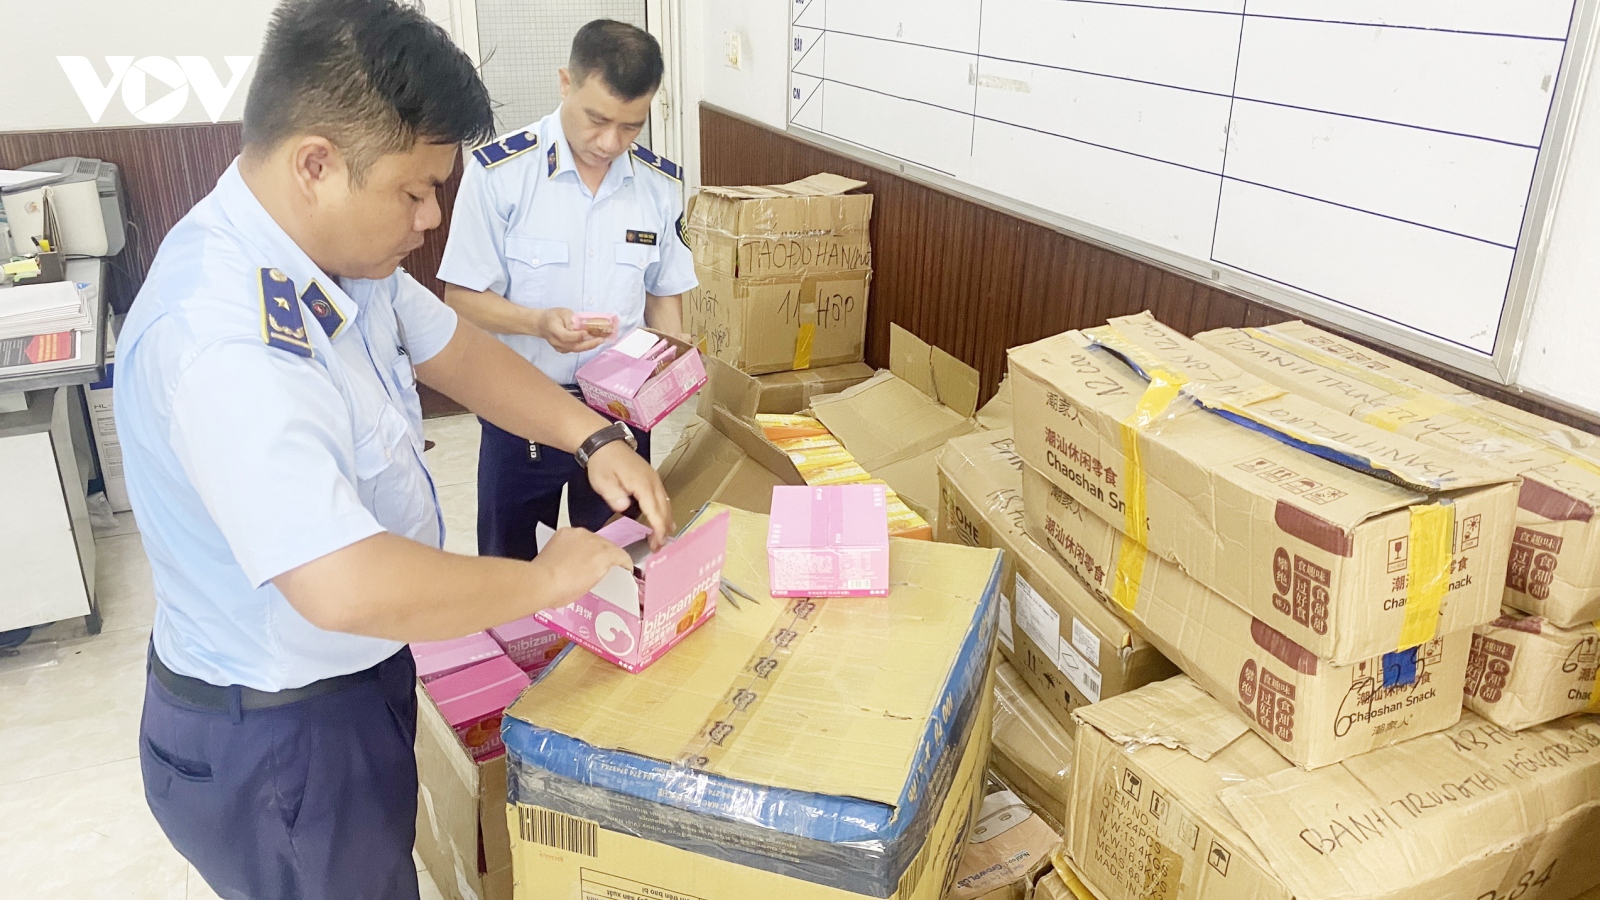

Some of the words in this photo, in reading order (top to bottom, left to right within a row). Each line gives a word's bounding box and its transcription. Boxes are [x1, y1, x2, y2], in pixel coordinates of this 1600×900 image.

[1043, 424, 1119, 489] 潮汕休闲零食
[1046, 449, 1105, 505] Chaoshan
[1108, 491, 1152, 533] Snk
[942, 487, 980, 546] GOHE
[1043, 513, 1107, 587] 潮汕休闲零食
[1296, 559, 1328, 584] 食趣味
[643, 593, 693, 634] bibizan
[1295, 579, 1309, 623] 过好食
[507, 632, 557, 653] bibizan
[1262, 672, 1292, 697] 食趣味
[1259, 690, 1274, 729] 过好食
[1349, 700, 1403, 729] Chaoshan
[1405, 687, 1437, 713] Snack
[1103, 781, 1131, 812] ITEM
[1094, 849, 1124, 885] MADE
[1125, 879, 1137, 896] IN
